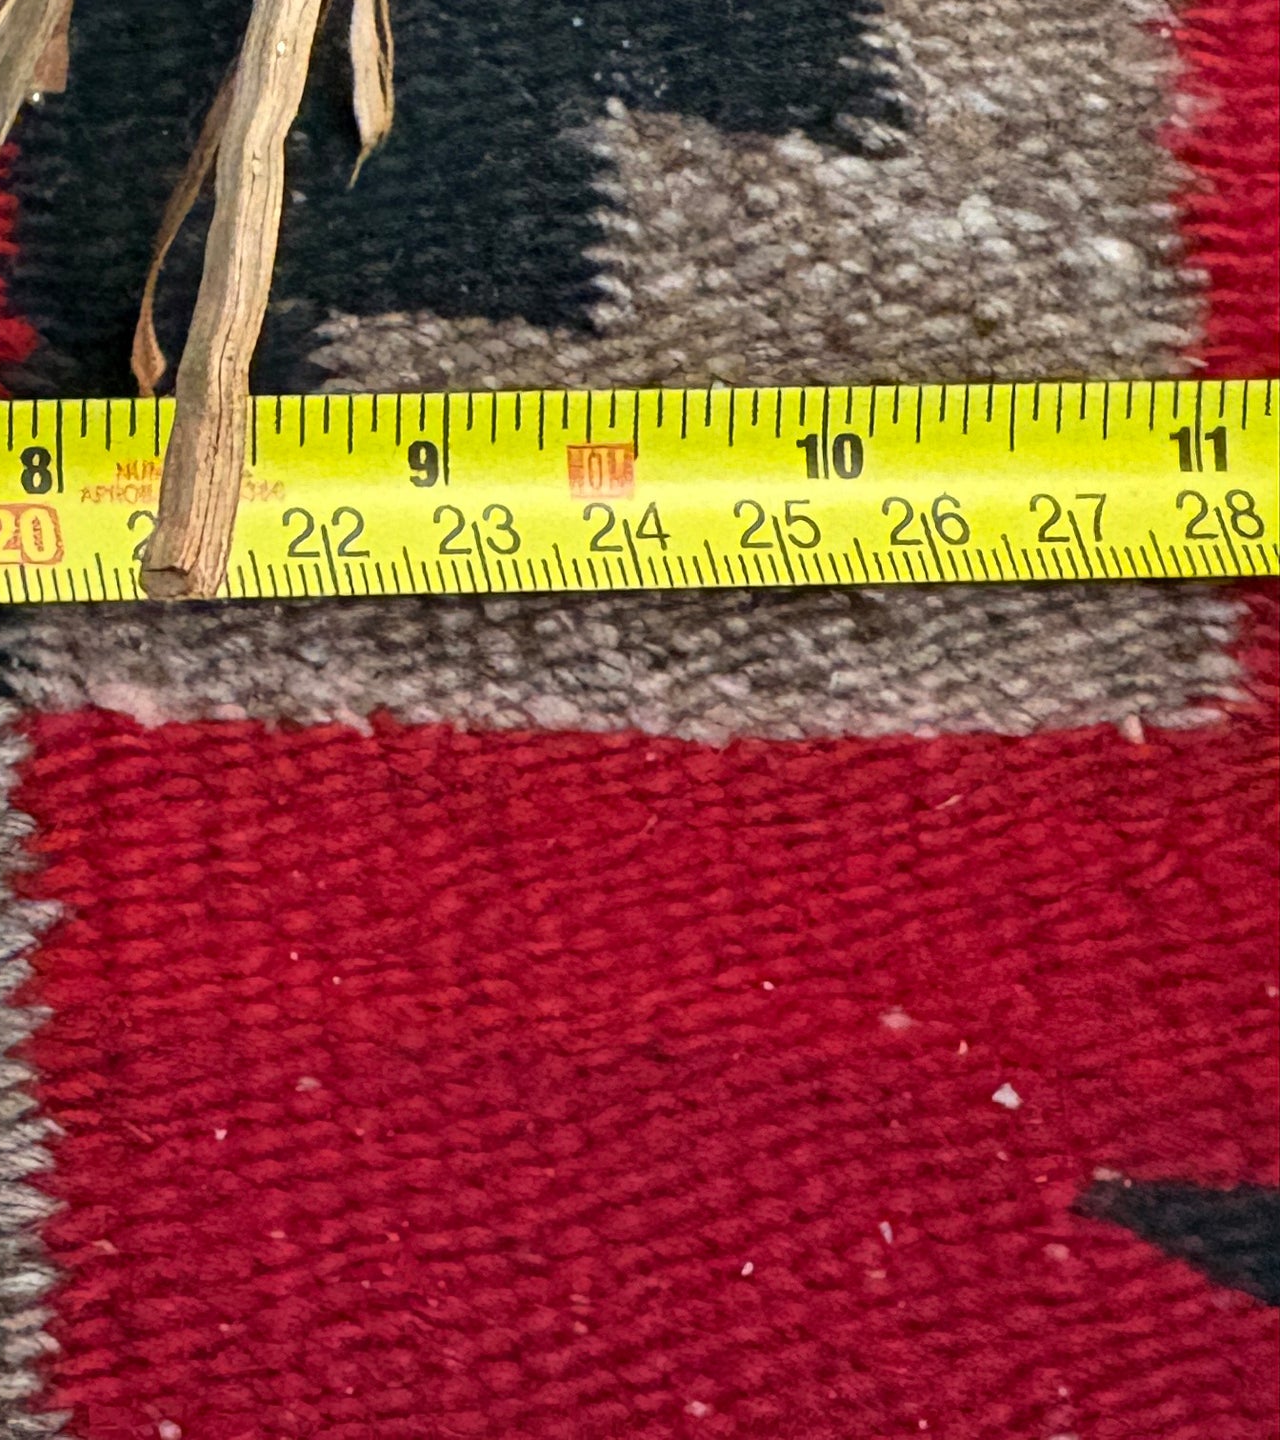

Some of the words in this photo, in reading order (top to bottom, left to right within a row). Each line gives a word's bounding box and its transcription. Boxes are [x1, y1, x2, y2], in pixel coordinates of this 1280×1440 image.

[19, 446, 53, 494] 8
[407, 440, 439, 487] 9
[796, 432, 864, 479] 10
[1169, 426, 1228, 472] 11
[282, 506, 370, 559] 22
[433, 504, 521, 555] 23
[583, 501, 671, 552] 24
[734, 499, 821, 549] 25
[882, 492, 970, 546] 26
[1030, 493, 1107, 542] 27
[1176, 489, 1265, 540] 28
